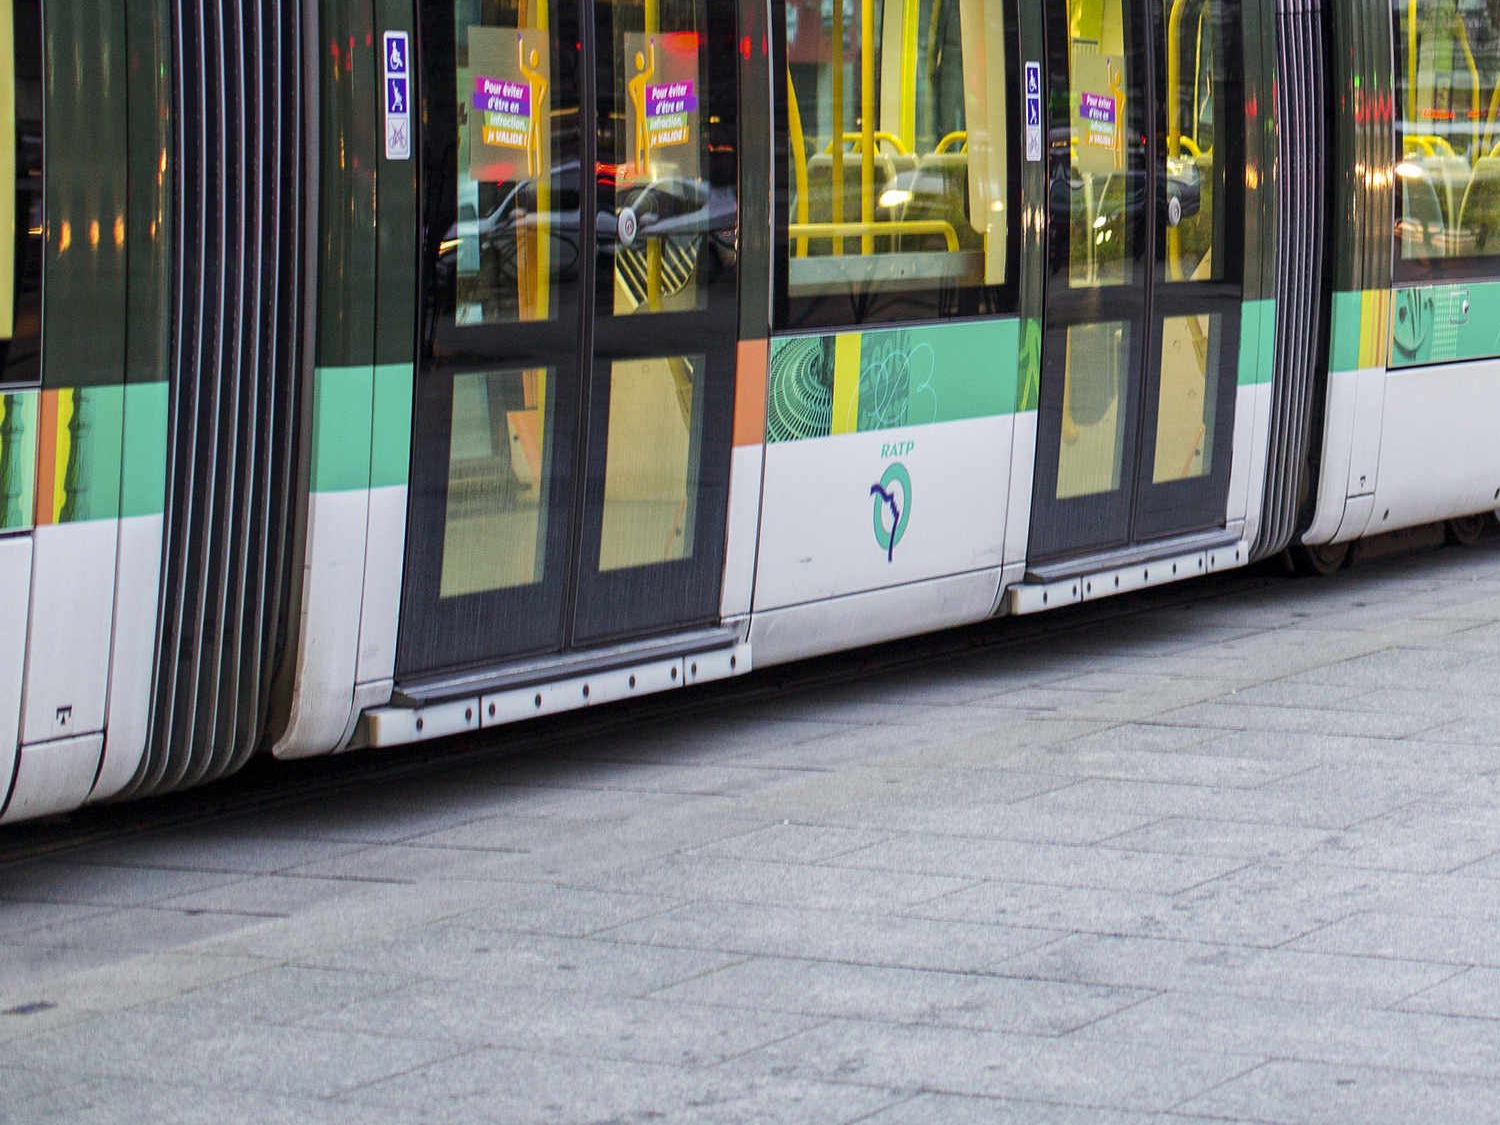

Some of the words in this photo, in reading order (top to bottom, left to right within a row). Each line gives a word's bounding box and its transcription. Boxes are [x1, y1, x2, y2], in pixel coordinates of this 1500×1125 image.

[484, 79, 501, 95] Pour
[503, 82, 524, 99] éviter
[652, 85, 667, 100] Pour
[488, 96, 509, 113] d'être
[510, 101, 519, 114] en
[676, 100, 684, 112] en
[880, 440, 915, 459] RATP
